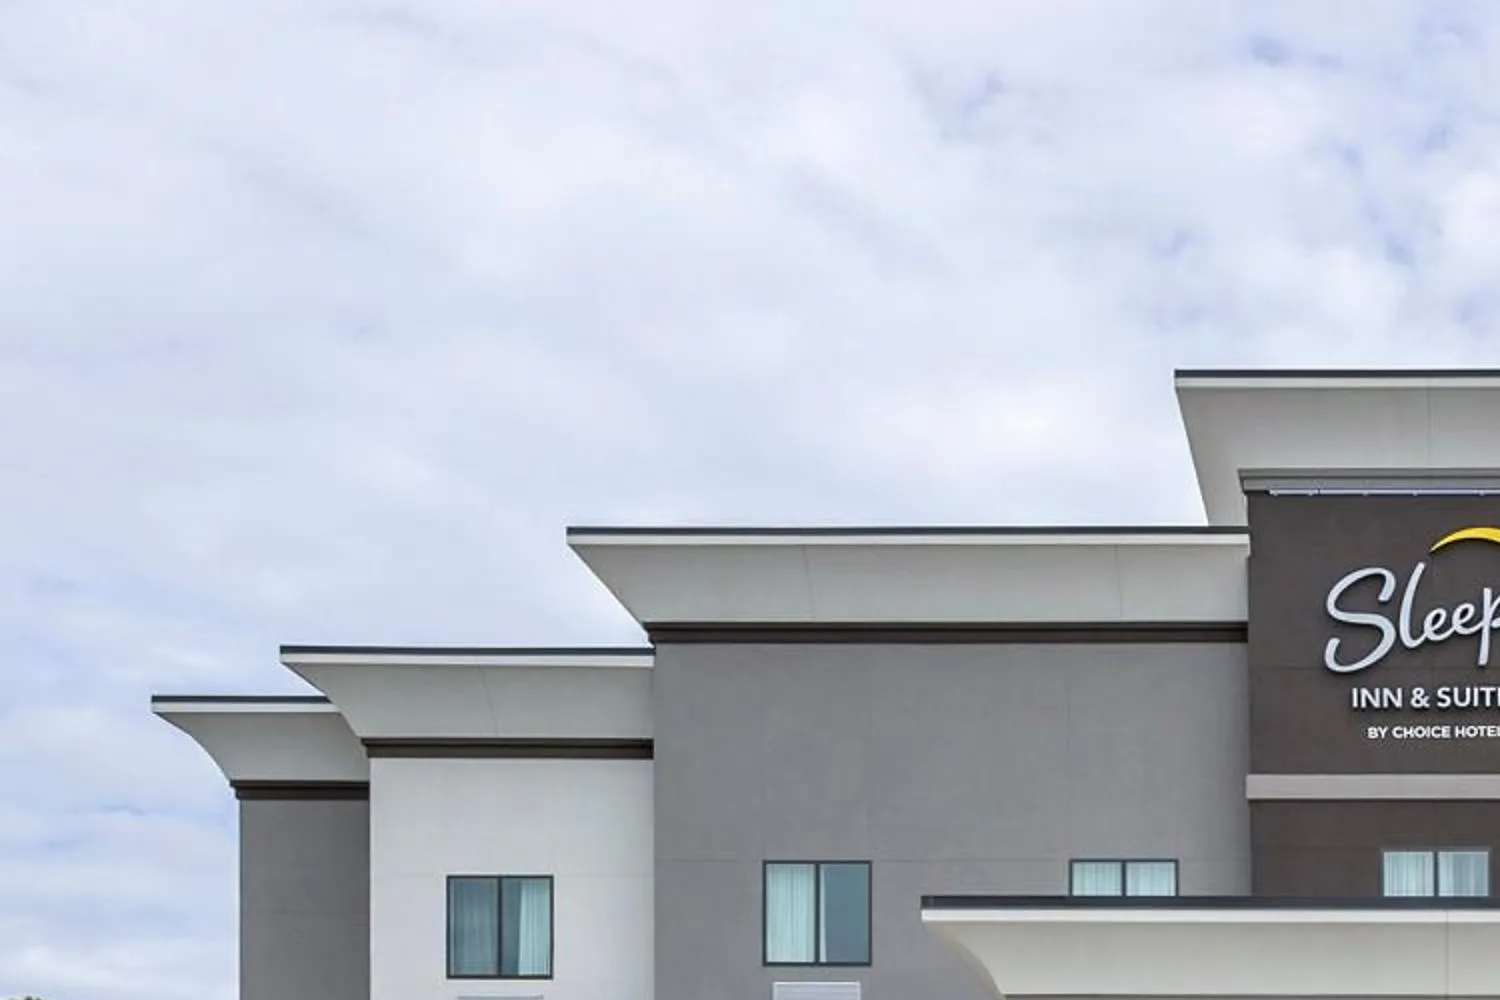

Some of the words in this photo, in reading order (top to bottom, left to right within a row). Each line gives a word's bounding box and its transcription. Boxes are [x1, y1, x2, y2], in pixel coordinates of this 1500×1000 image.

[1351, 686, 1403, 709] INN
[1410, 686, 1430, 709] &
[1367, 725, 1389, 740] BY
[1392, 725, 1451, 739] CHOICE
